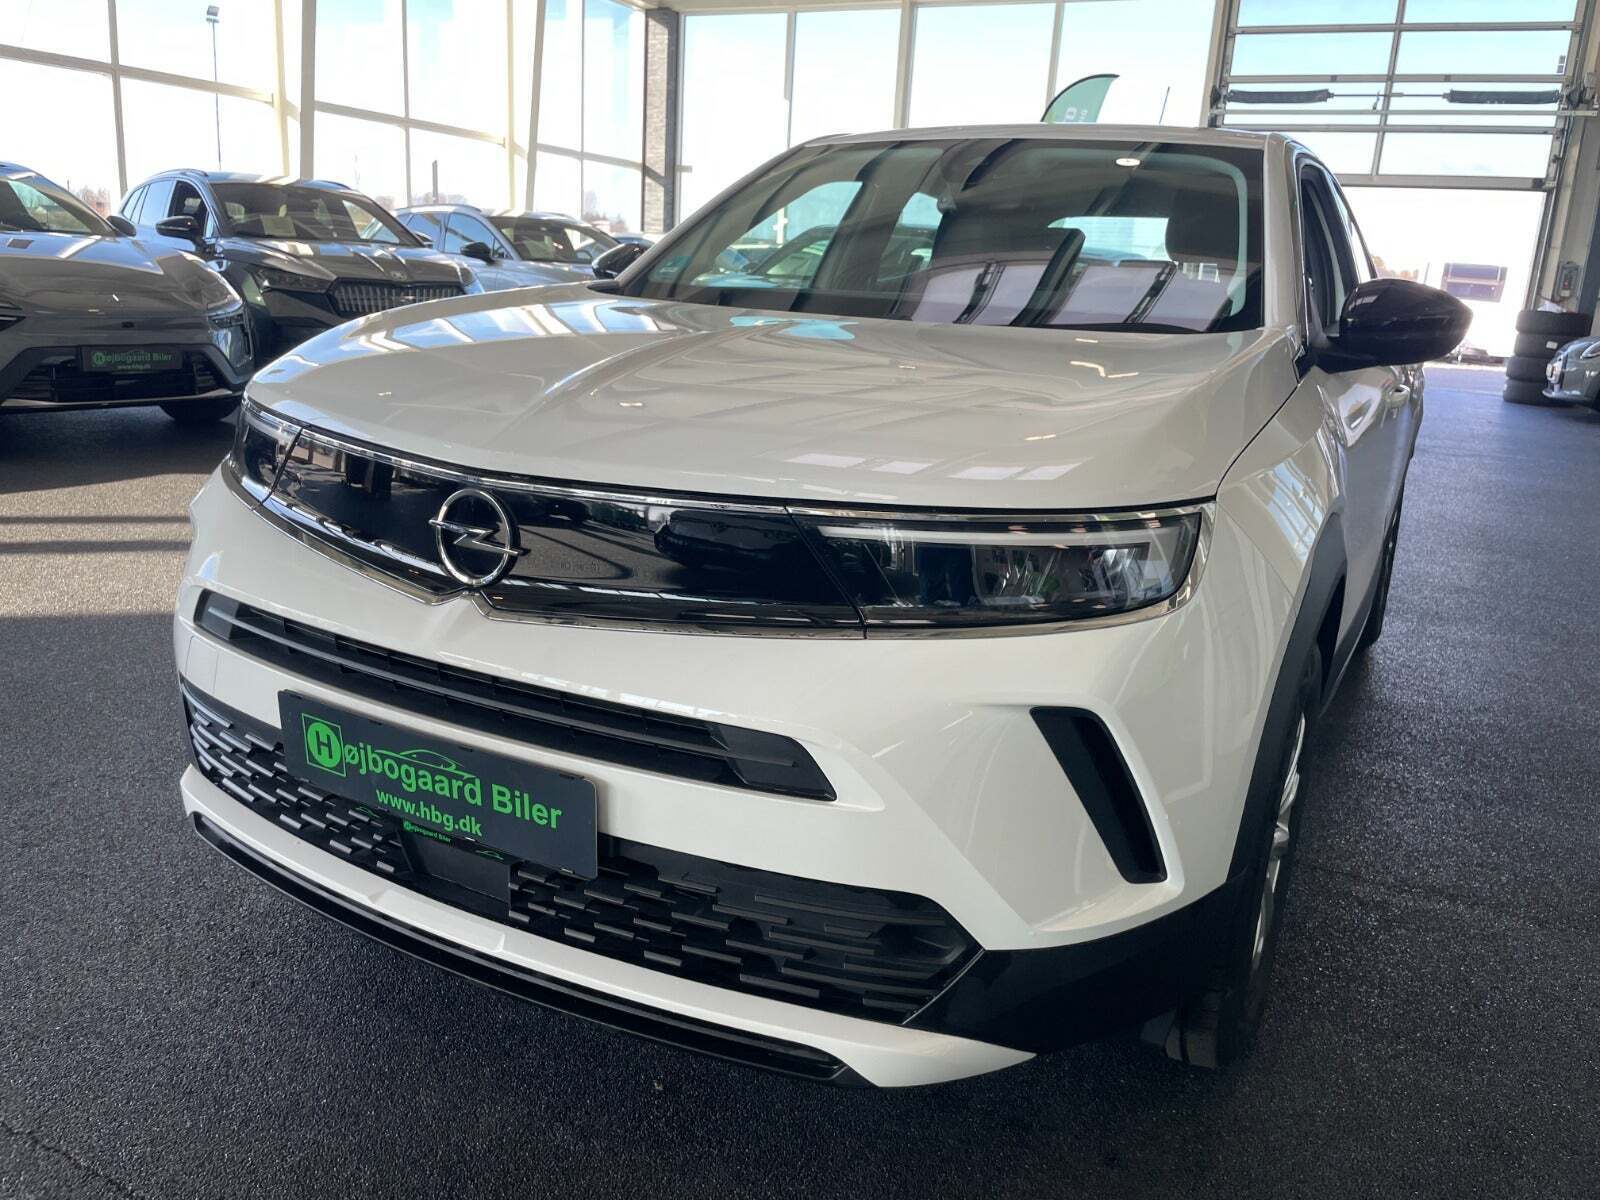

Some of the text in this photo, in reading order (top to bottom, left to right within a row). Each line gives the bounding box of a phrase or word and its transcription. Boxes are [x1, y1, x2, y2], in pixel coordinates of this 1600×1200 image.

[304, 715, 563, 830] Højbogaard Biler
[376, 789, 483, 837] www.hbg.dk
